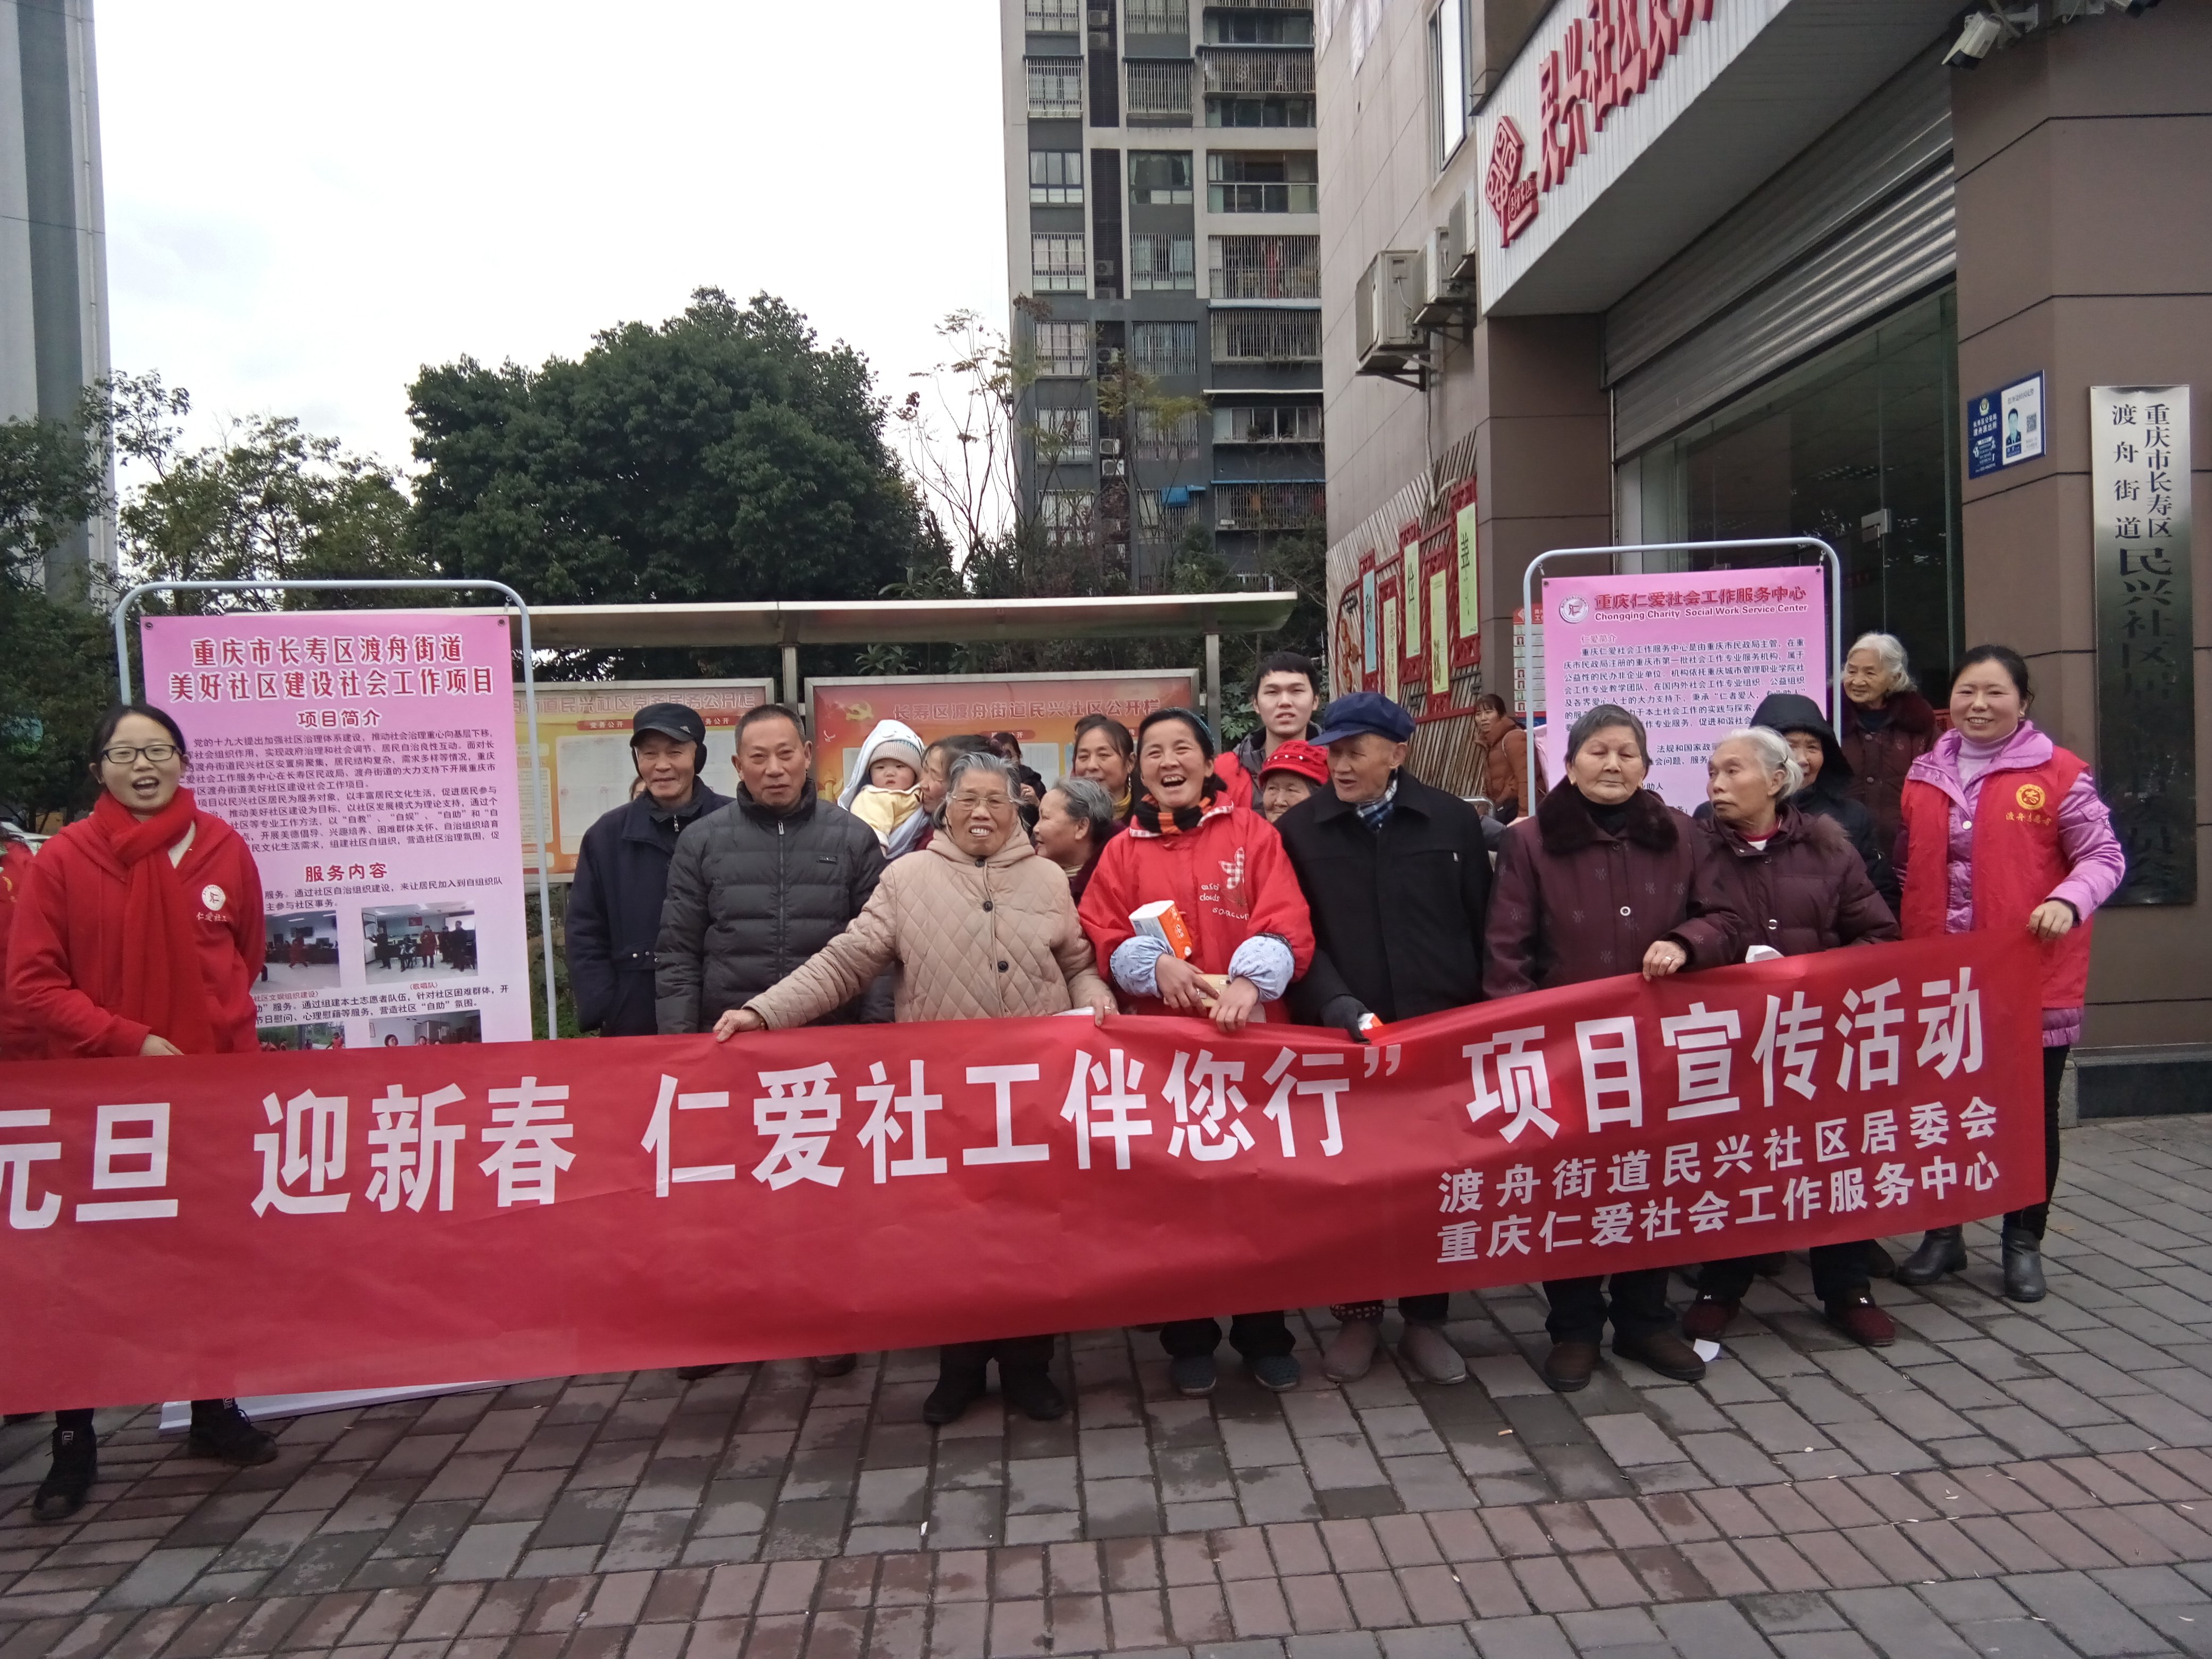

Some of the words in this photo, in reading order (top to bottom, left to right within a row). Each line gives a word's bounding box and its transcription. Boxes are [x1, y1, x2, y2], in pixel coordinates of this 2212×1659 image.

[1540, 0, 1713, 192] 民兴社区
[2112, 404, 2141, 539] 渡舟街道
[2144, 404, 2173, 538] 重庆市长寿区
[1595, 585, 1807, 610] 重庆仁爱社会工作服务中心
[1595, 611, 1645, 621] Chongqing
[1647, 610, 1680, 618] Charity
[1685, 608, 1712, 616] Social
[192, 635, 464, 668] 重庆市长寿区渡舟街道
[1581, 634, 1617, 643] 仁爱简介
[170, 666, 495, 702] 美好社区建设社会工作项目
[297, 709, 381, 728] 项目简介
[893, 698, 1161, 720] 长寿区渡舟街道民兴社区公开栏
[305, 862, 388, 883] 服务内容
[0, 1102, 178, 1230] 元旦
[251, 1076, 576, 1218] 迎新春
[640, 1043, 1402, 1197] 仁爱社工伴您行”
[1462, 967, 1984, 1143] 项目宣传活动
[1438, 1096, 1998, 1214] 渡舟街道民兴社区居委会
[1437, 1151, 2000, 1263] 重庆仁爱社会工作服务中心
